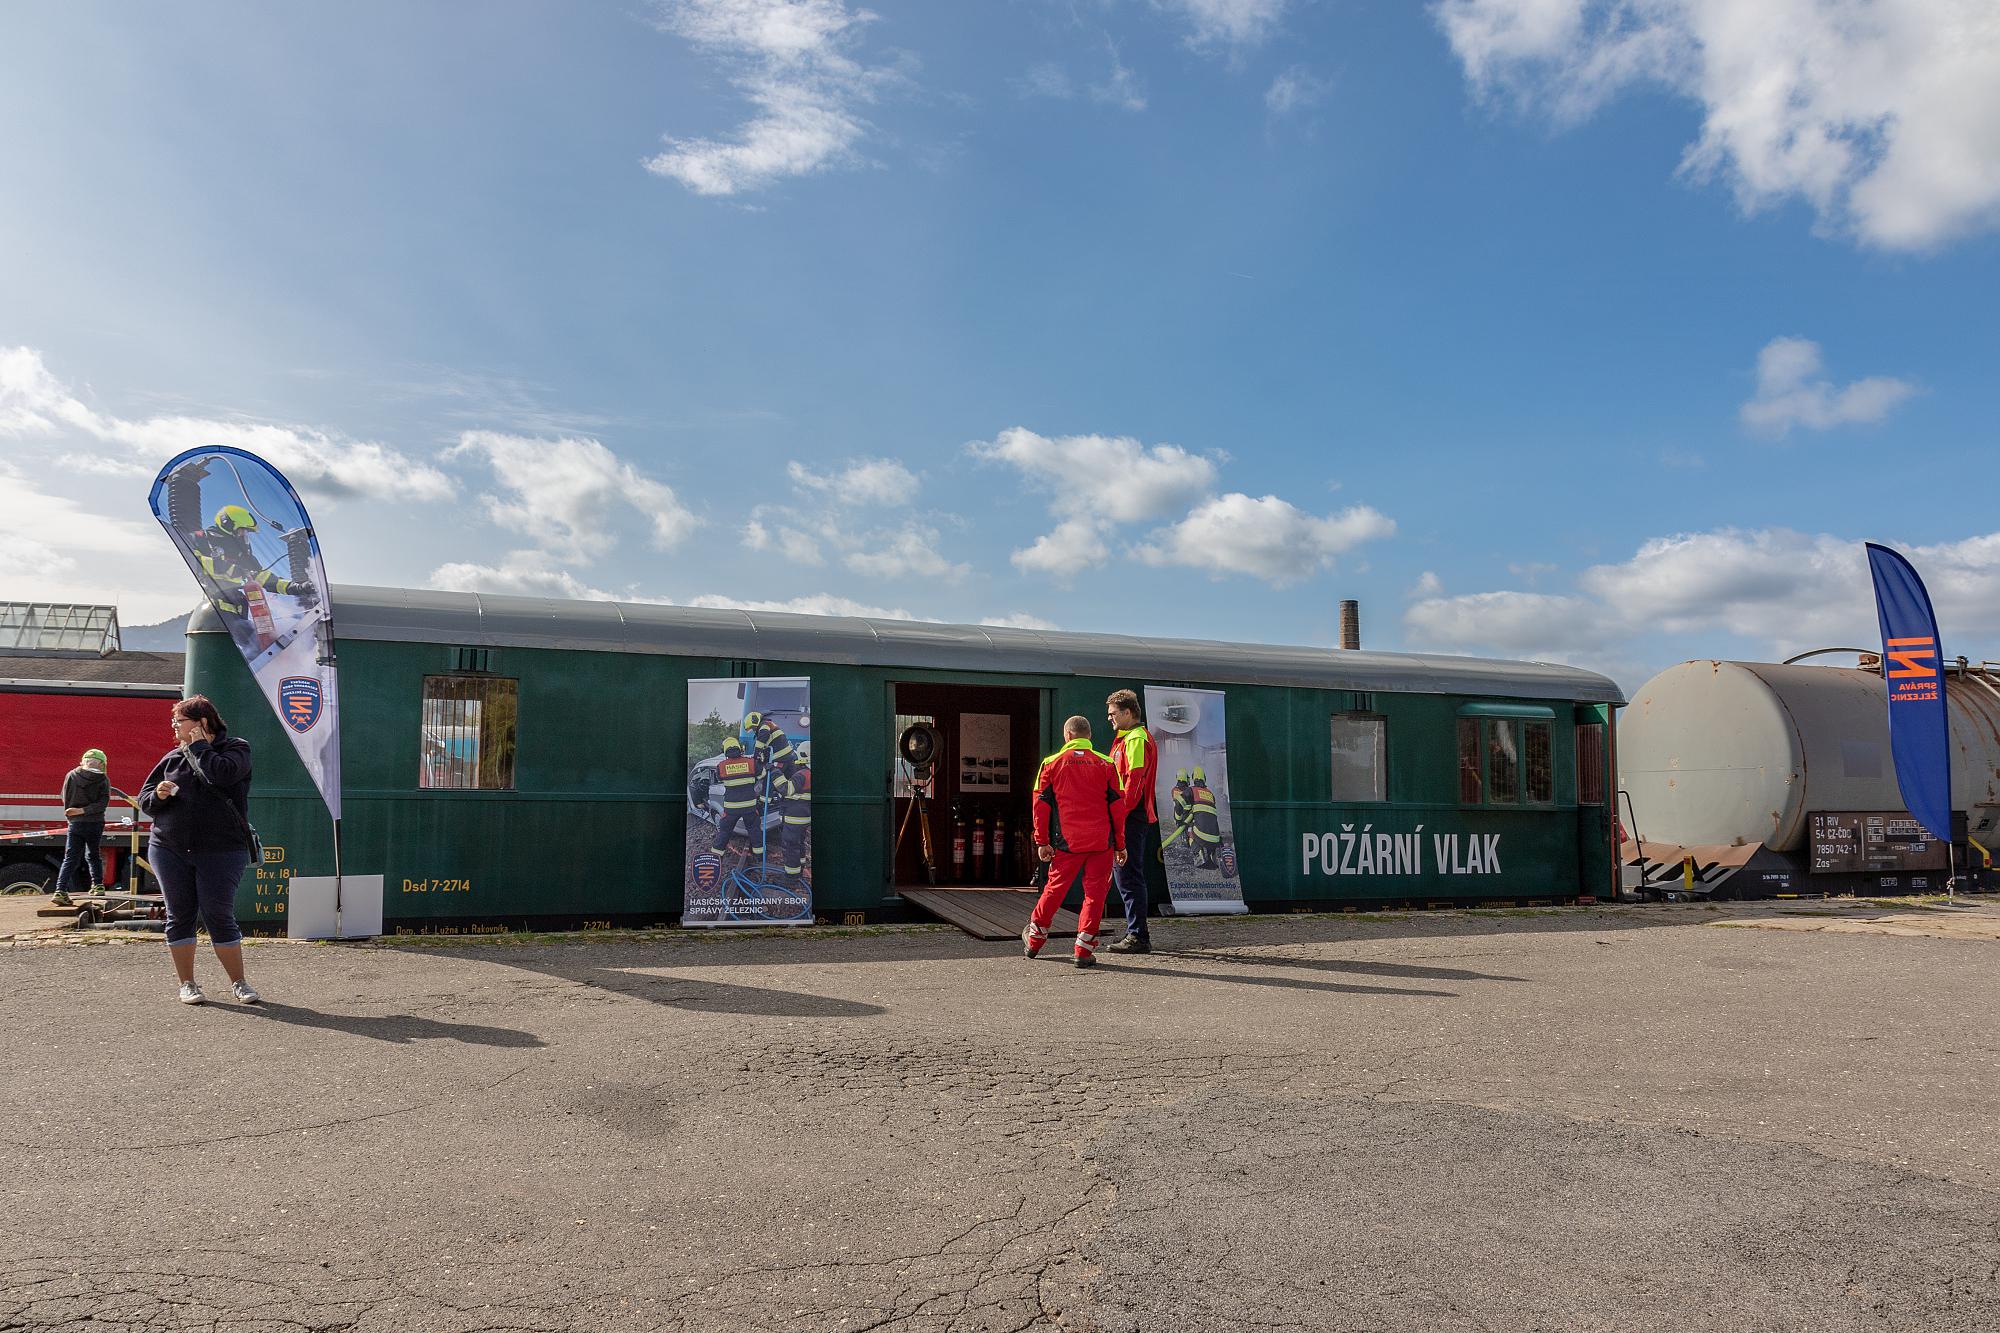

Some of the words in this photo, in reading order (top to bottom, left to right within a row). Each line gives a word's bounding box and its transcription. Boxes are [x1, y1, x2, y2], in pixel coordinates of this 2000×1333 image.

[1815, 816, 1824, 826] 31
[1827, 816, 1839, 826] RIV
[1815, 829, 1825, 839] 54
[1302, 823, 1424, 875] POŽÁRNÍ
[1433, 833, 1501, 875] VLAK
[1816, 844, 1834, 854] 7850
[1816, 858, 1830, 868] Zas
[403, 878, 428, 892] Dsd
[431, 879, 470, 892] 7-2714
[690, 897, 731, 906] HASIČSKÝ
[732, 896, 782, 906] ZÁCHRANNÝ
[784, 897, 808, 905] SBOR
[690, 905, 723, 915] SPRÁVY
[724, 905, 763, 914] ŽELEZNIC
